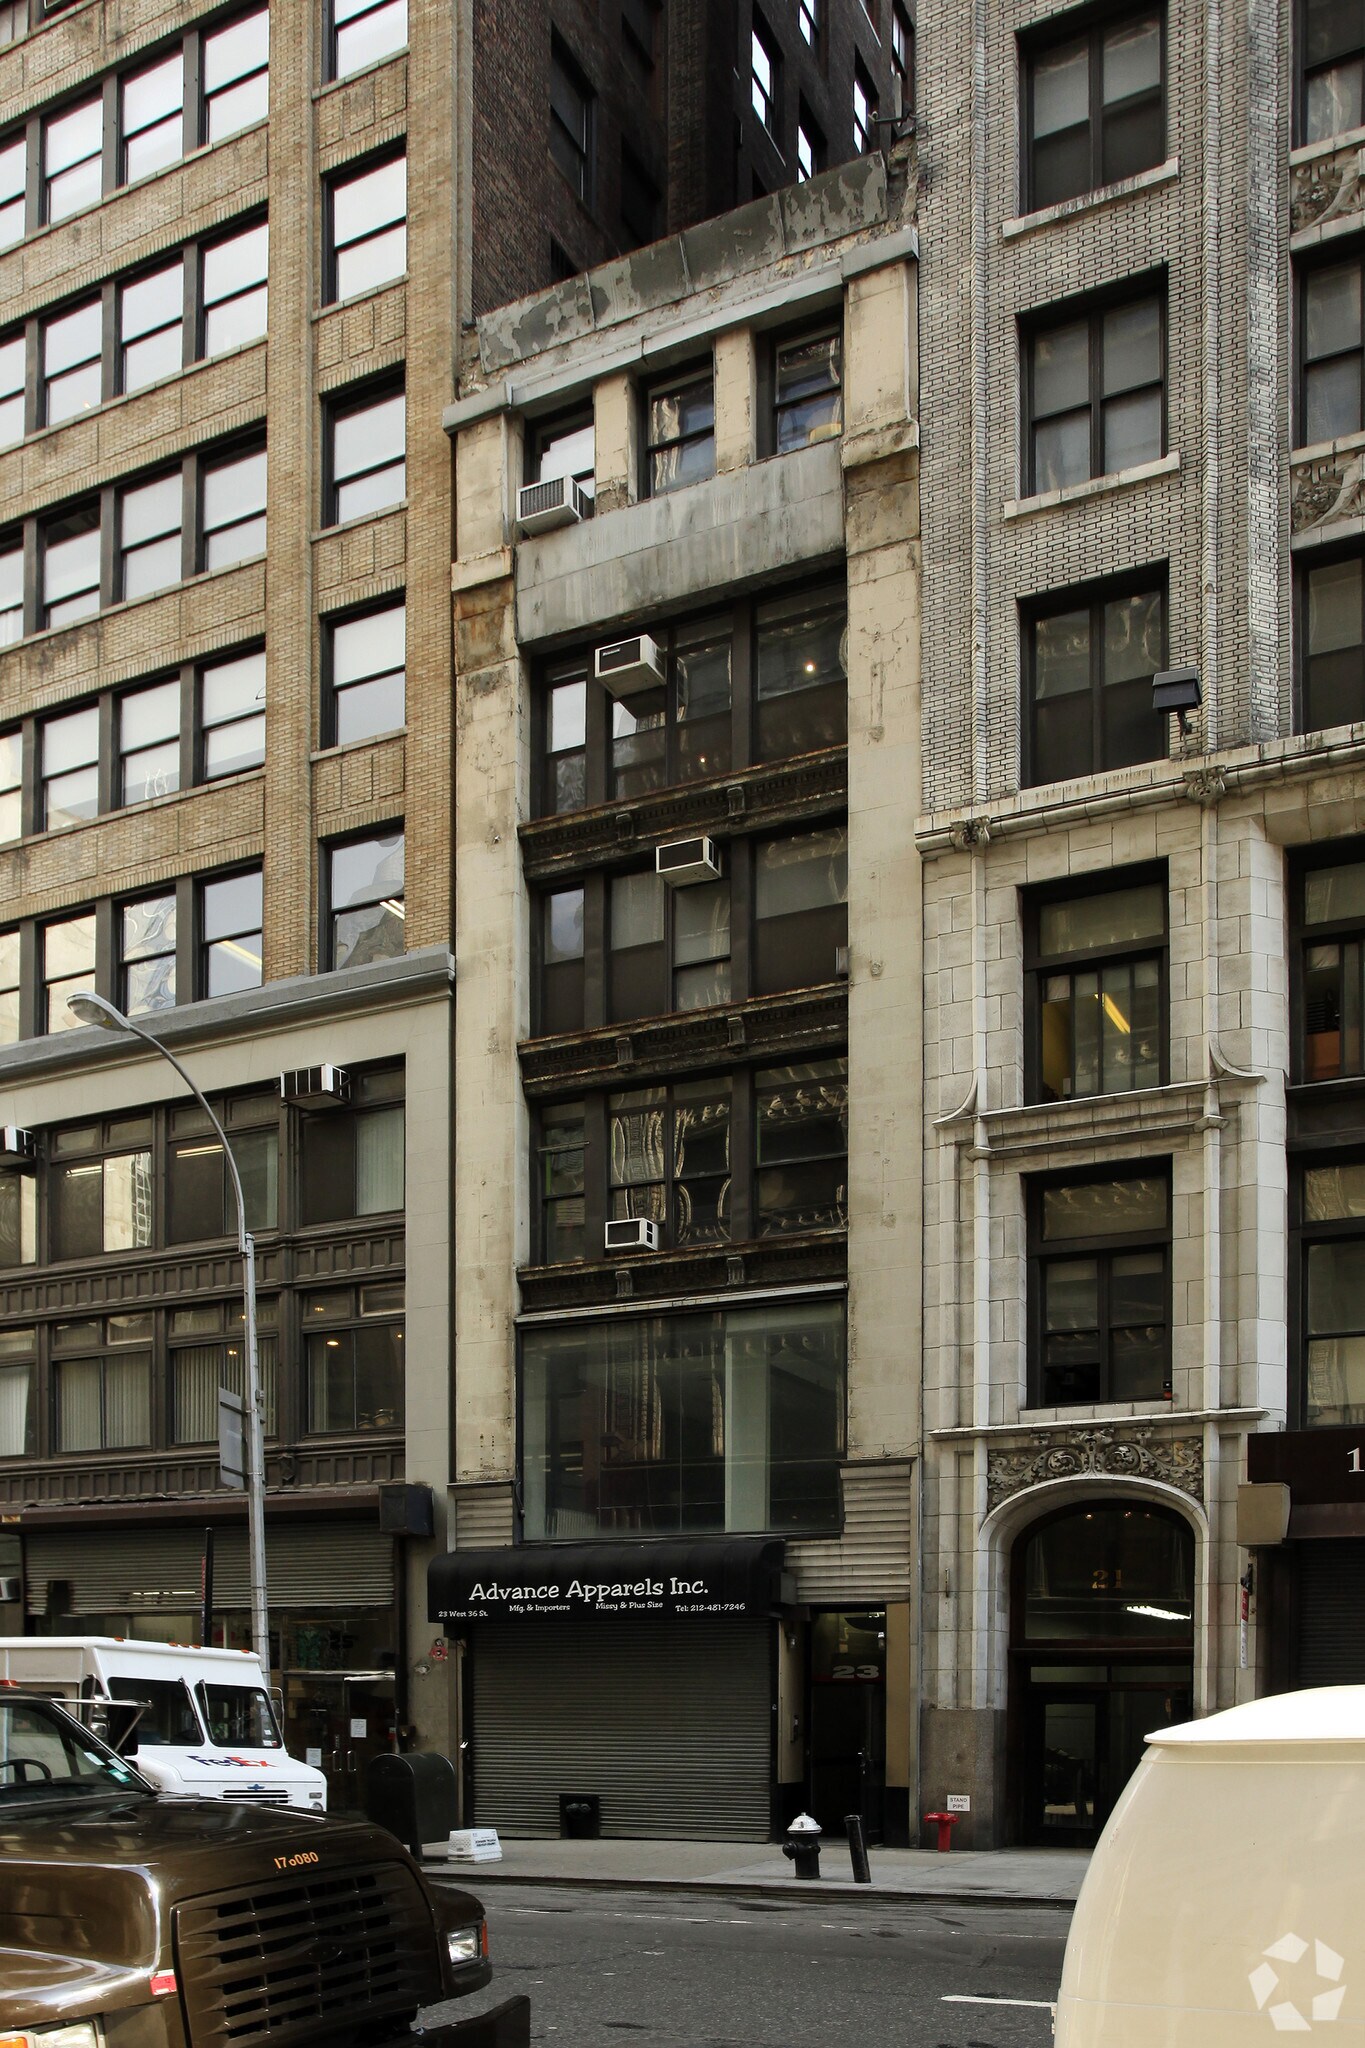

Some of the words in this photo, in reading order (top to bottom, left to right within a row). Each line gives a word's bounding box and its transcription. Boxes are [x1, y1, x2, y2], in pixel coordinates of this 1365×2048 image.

[1091, 1569, 1123, 1589] 21
[468, 1582, 560, 1601] Advance
[565, 1577, 664, 1603] Apparels
[669, 1576, 709, 1596] Inc.
[509, 1604, 525, 1614] Mfg.
[526, 1604, 534, 1612] &
[535, 1603, 571, 1613] Importers
[595, 1602, 618, 1611] Missy
[619, 1601, 628, 1609] &
[628, 1601, 646, 1609] Plus
[646, 1600, 663, 1609] Size
[674, 1604, 689, 1612] Tel:
[690, 1602, 746, 1612] 212-481-7246
[438, 1610, 448, 1618] 23
[449, 1610, 467, 1618] West
[468, 1609, 478, 1617] 36
[479, 1609, 489, 1617] St.
[832, 1664, 880, 1679] 23
[185, 1755, 278, 1767] FedEx
